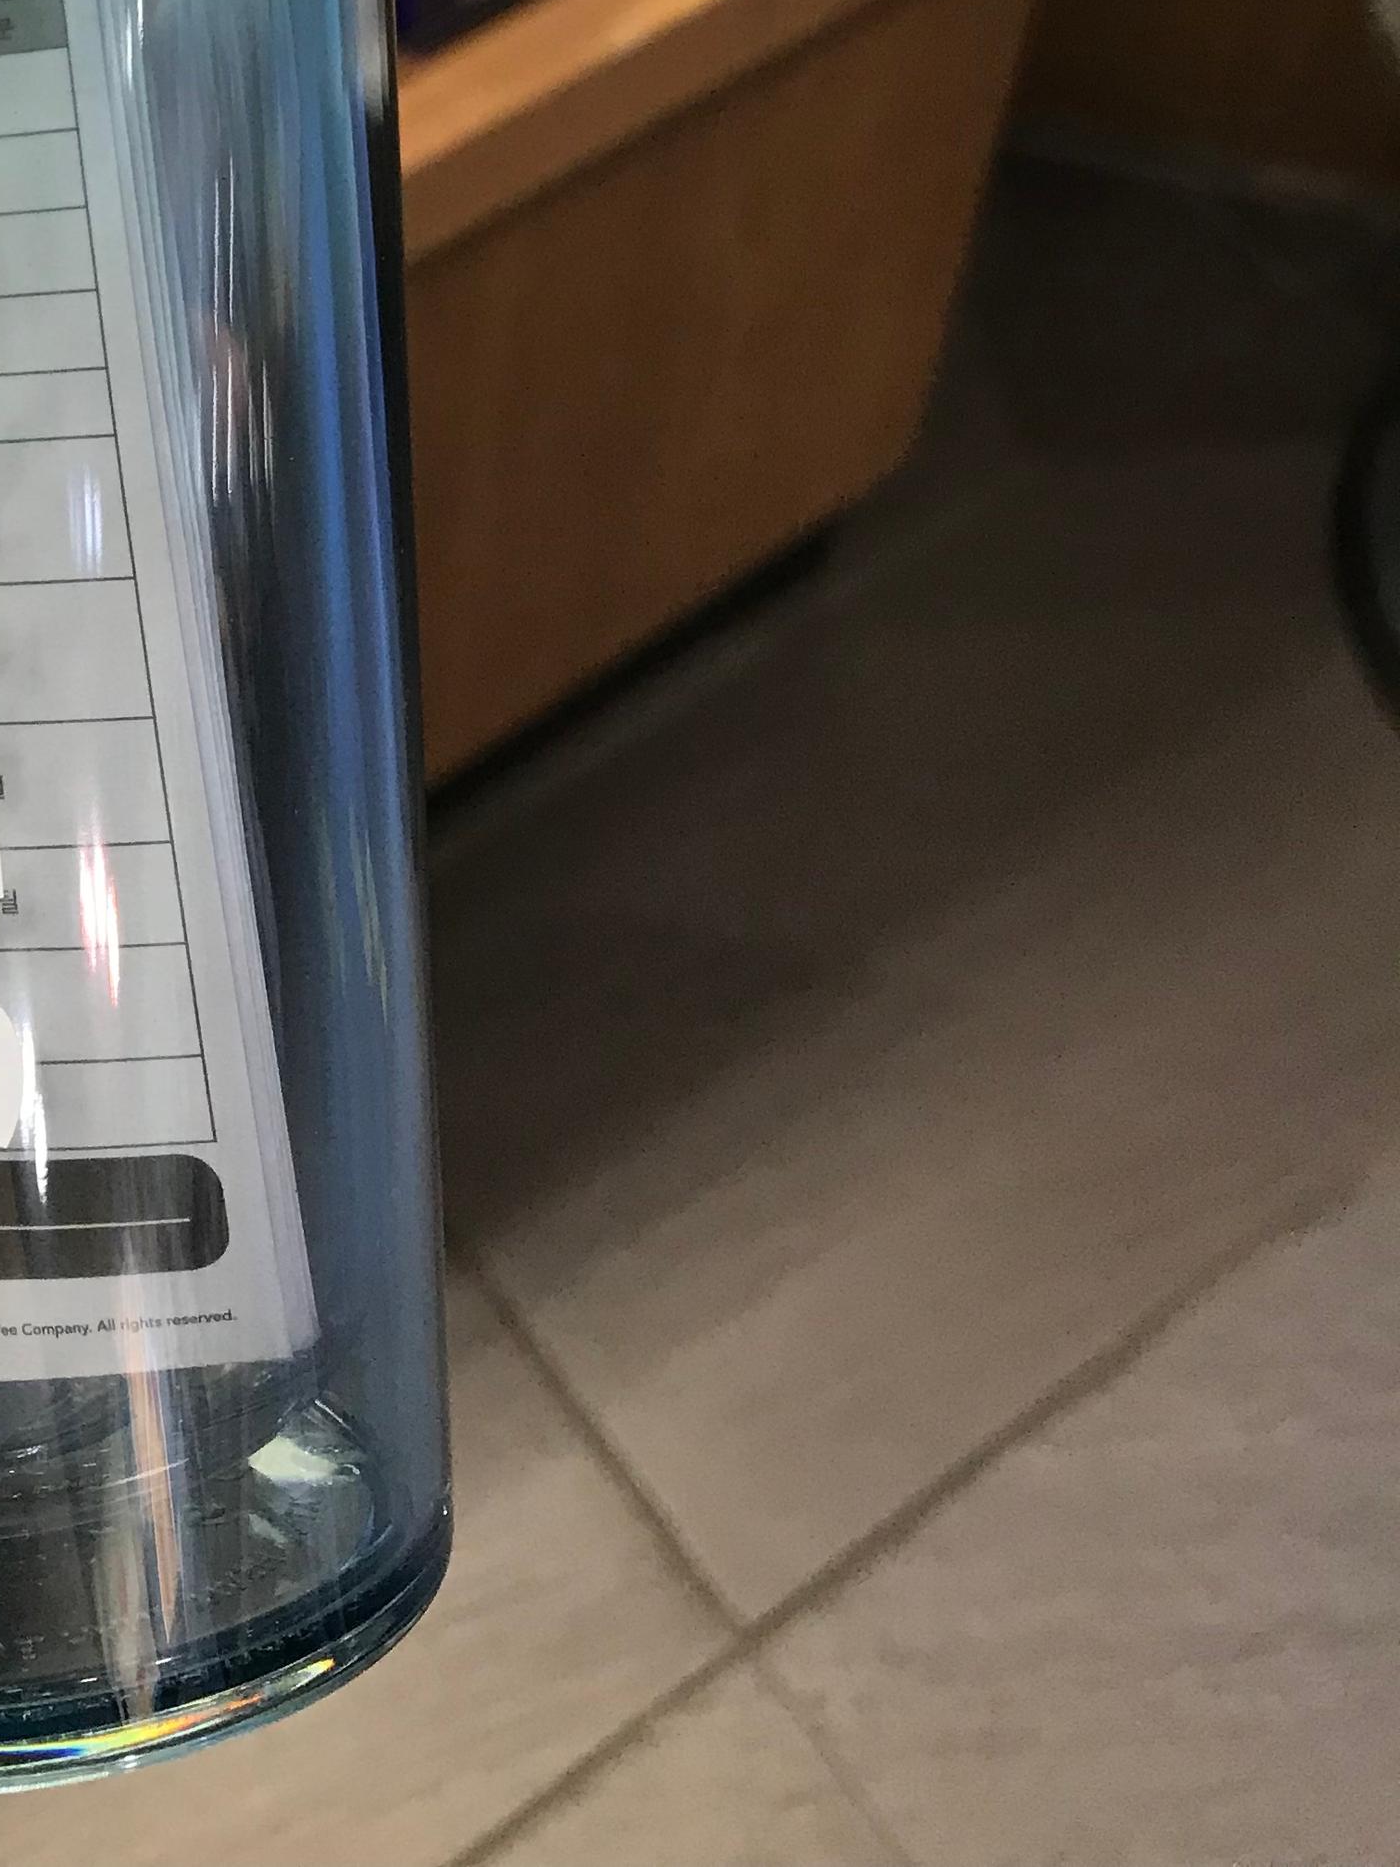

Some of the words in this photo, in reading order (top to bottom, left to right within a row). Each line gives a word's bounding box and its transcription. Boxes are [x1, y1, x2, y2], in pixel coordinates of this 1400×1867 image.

[22, 1321, 92, 1339] Company.
[97, 1318, 116, 1334] All
[120, 1314, 162, 1334] rights
[166, 1308, 237, 1327] reserved.
